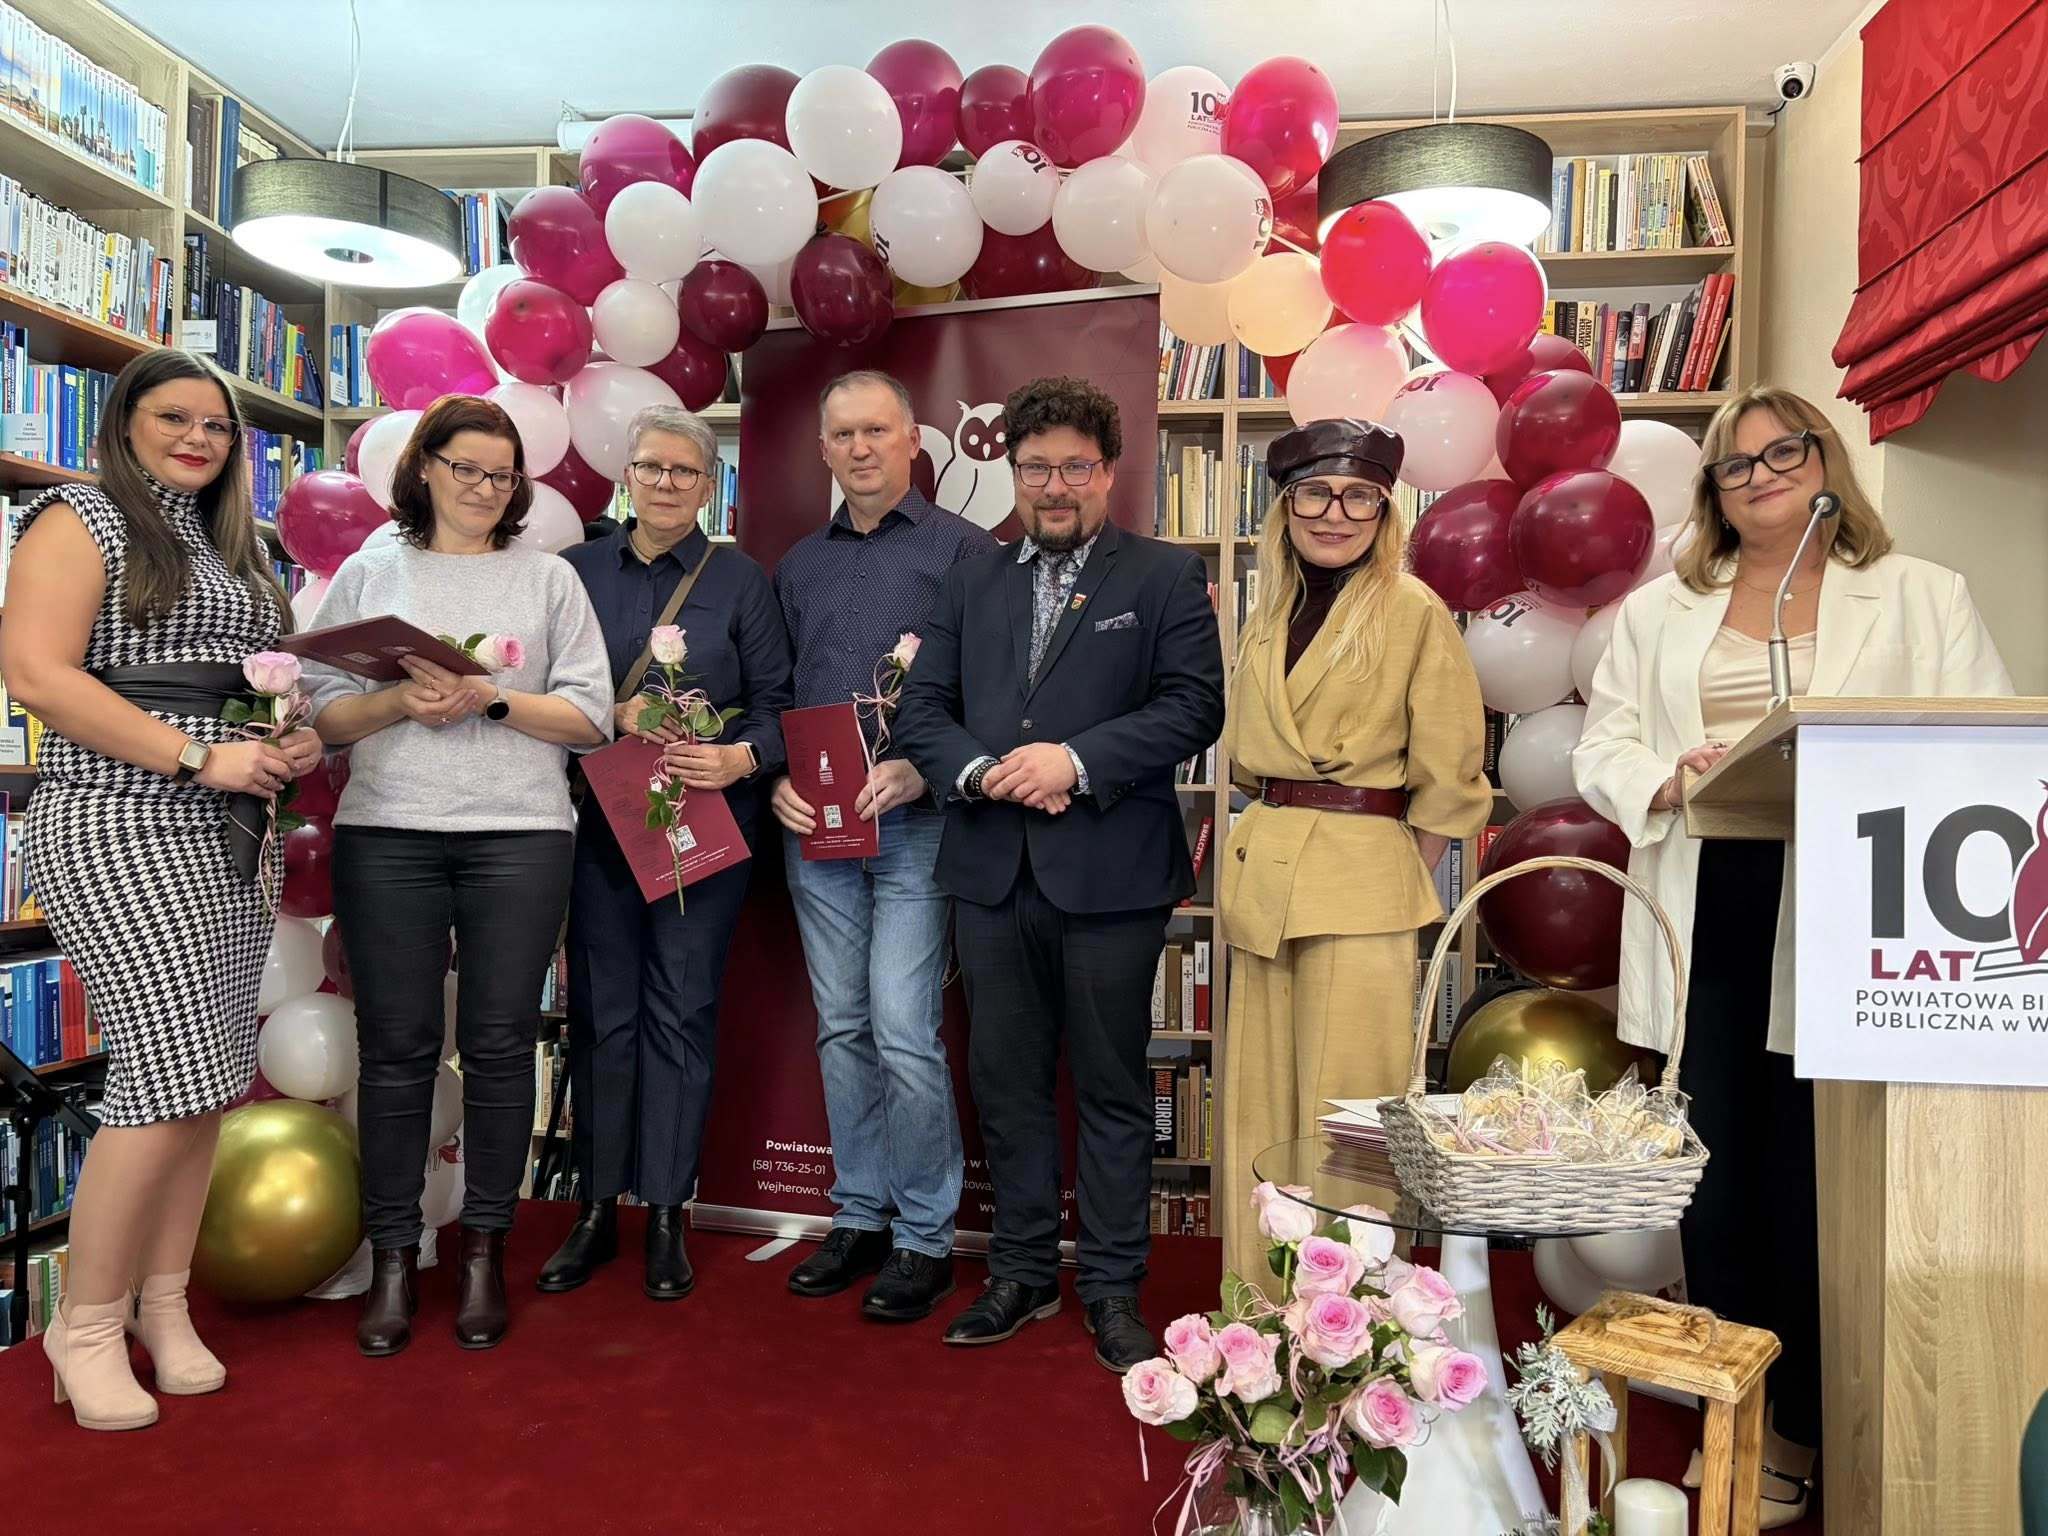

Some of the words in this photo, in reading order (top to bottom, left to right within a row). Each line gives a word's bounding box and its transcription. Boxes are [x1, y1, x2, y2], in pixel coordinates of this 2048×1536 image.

[1584, 318, 1593, 348] ARMIA
[1871, 948, 1976, 982] LAT
[1856, 990, 2014, 1011] POWIATOWA
[1856, 1010, 1994, 1032] PUBLICZNA
[2001, 1019, 2020, 1032] w
[1154, 1096, 1173, 1142] EUROPA
[766, 1140, 833, 1155] Powiatowa
[752, 1159, 773, 1172] (58)
[775, 1161, 826, 1175] 736-25-01
[757, 1180, 821, 1197] Wejherowo,
